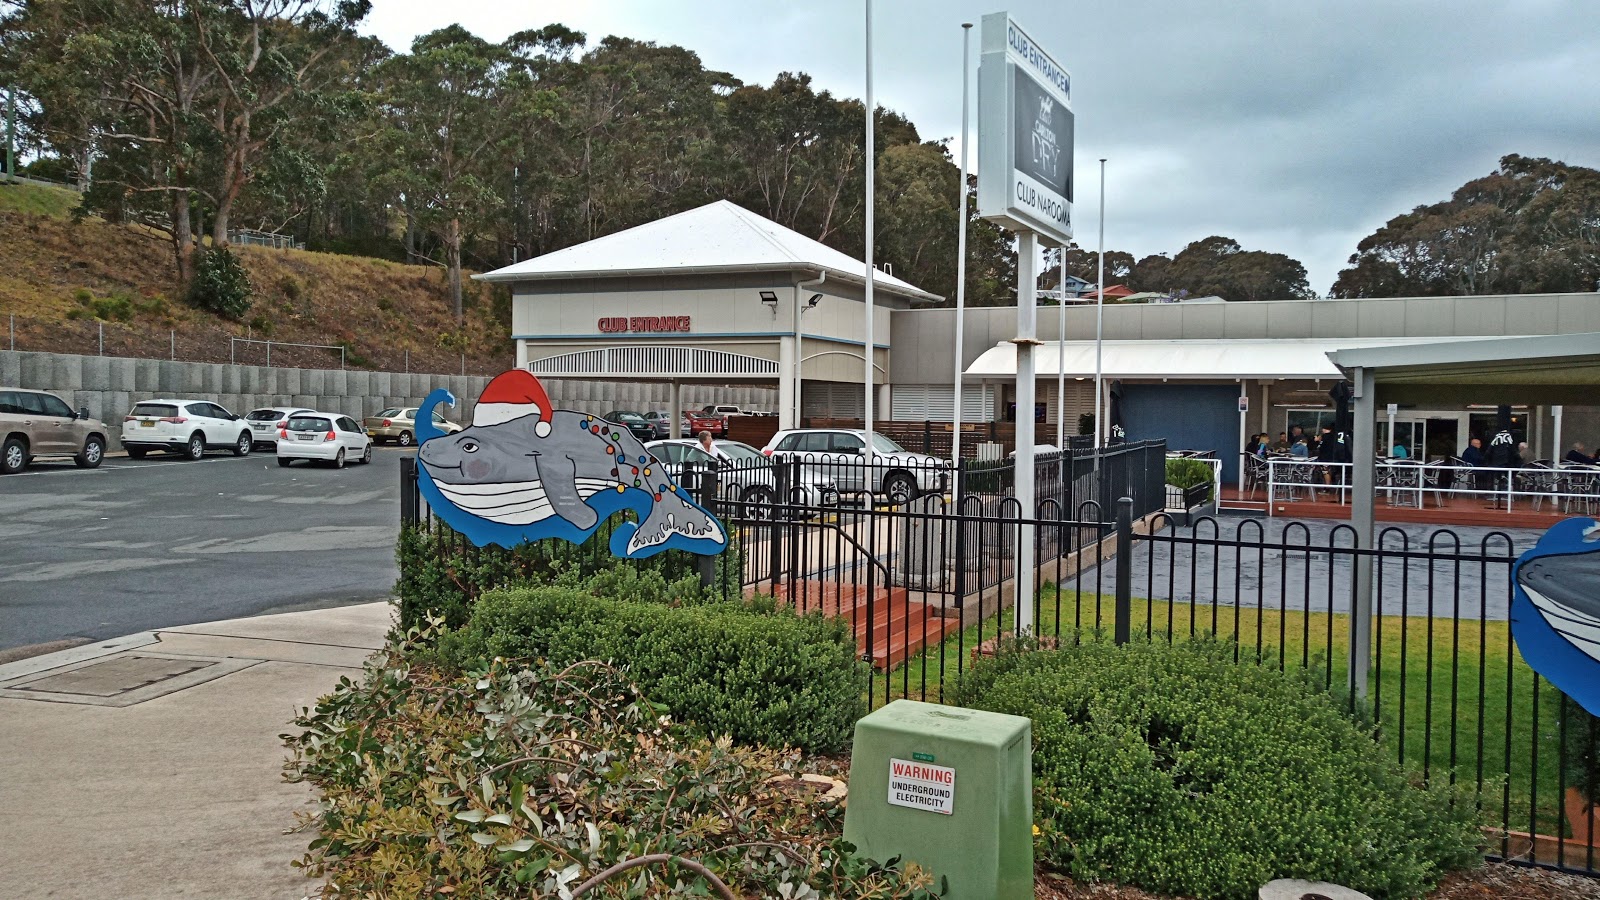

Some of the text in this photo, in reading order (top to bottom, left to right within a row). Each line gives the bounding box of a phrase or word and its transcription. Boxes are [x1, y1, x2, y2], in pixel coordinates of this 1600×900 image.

[1008, 26, 1065, 92] CLUB ENTRANCE
[1016, 181, 1071, 228] CLUB NAROOMA
[598, 315, 690, 333] CLUB ENTRANCE
[893, 762, 952, 784] WARNING
[891, 781, 951, 799] UNDERGROUND
[896, 792, 945, 808] ELECTRICITY
